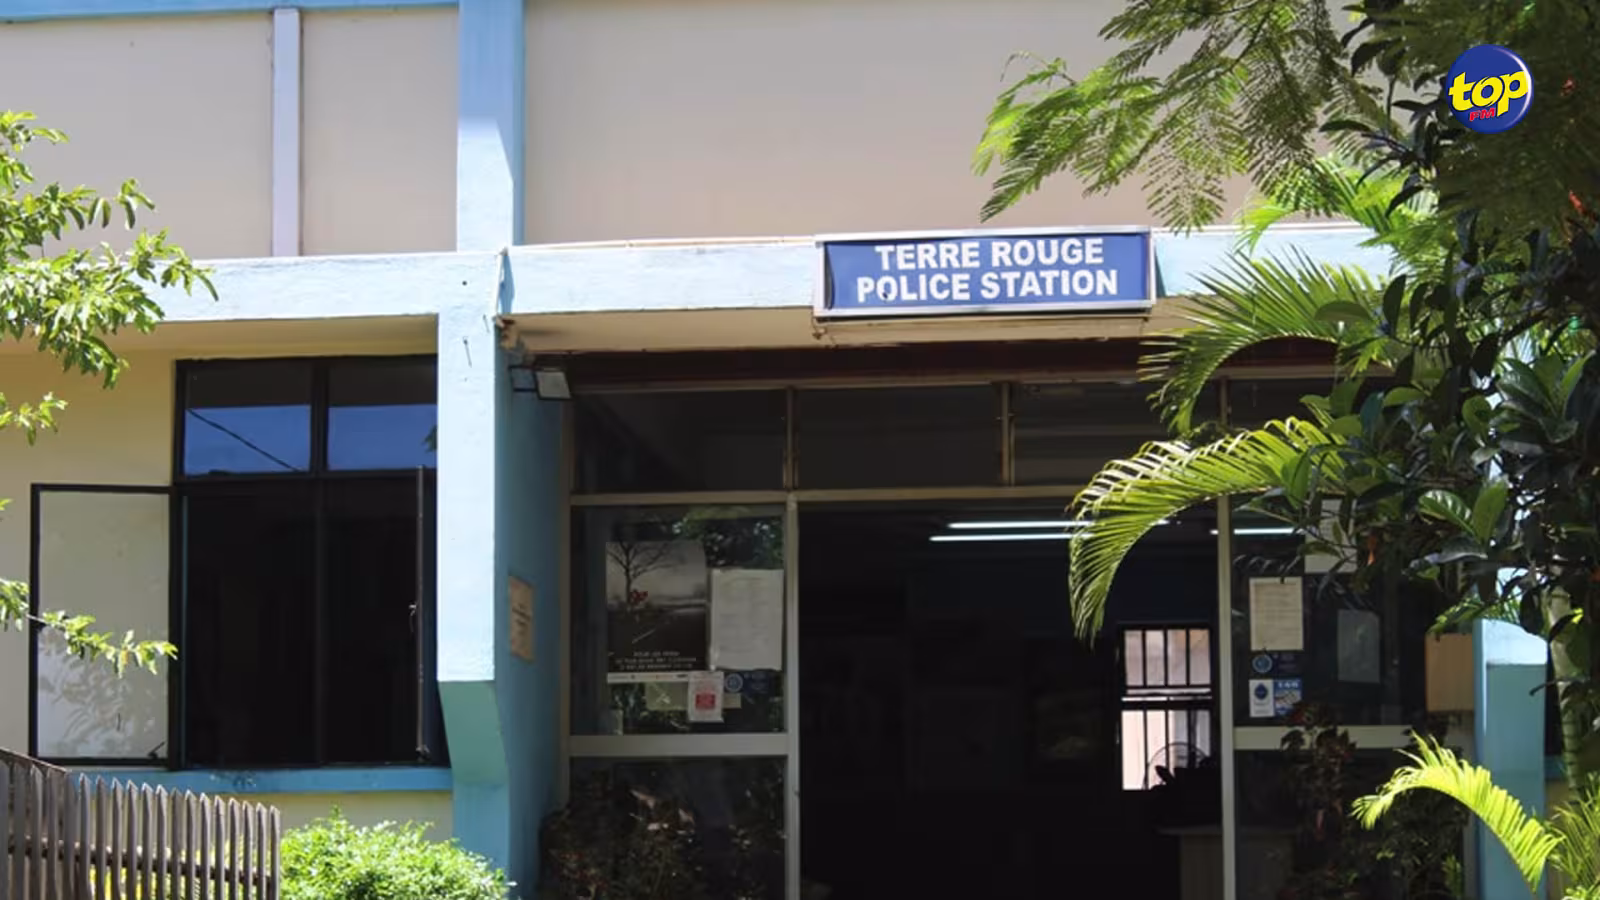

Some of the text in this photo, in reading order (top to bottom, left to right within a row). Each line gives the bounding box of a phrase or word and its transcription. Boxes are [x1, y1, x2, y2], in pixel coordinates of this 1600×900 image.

[875, 238, 1104, 270] TERRE ROUGE
[857, 269, 1117, 303] POLICE STATION
